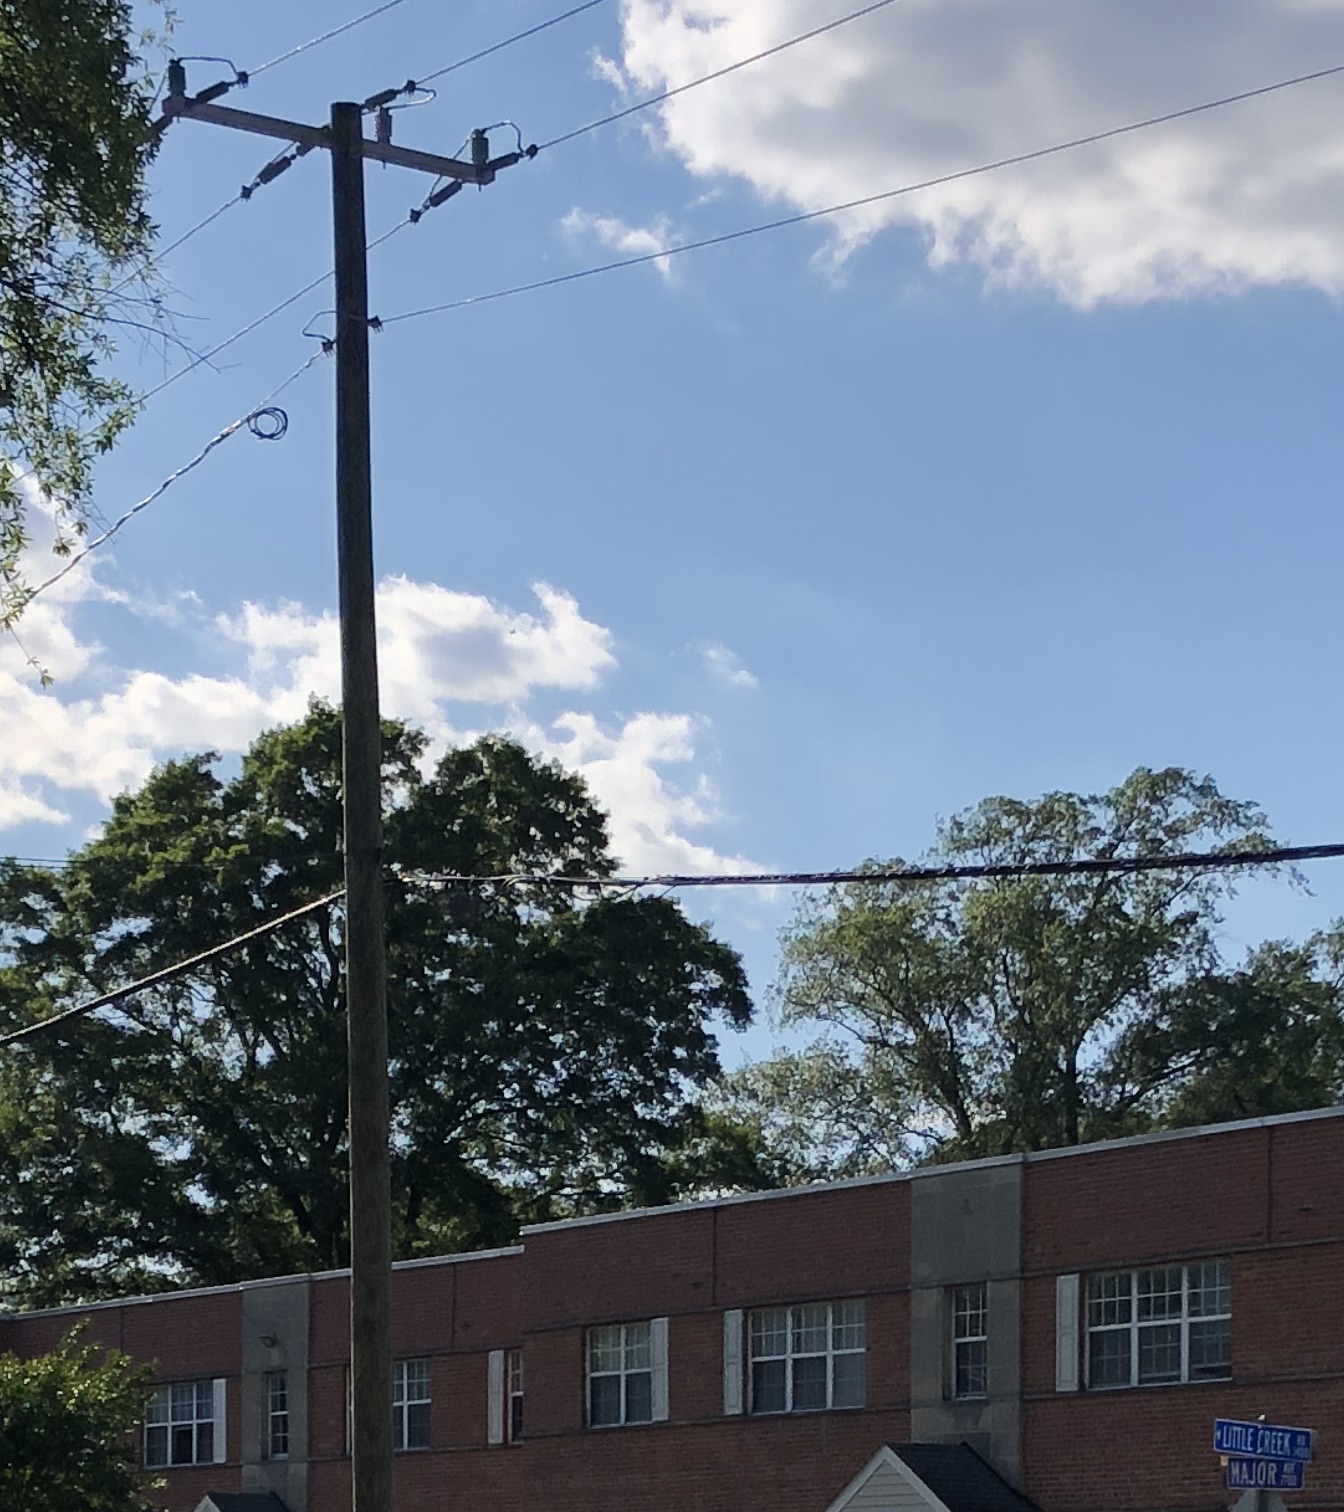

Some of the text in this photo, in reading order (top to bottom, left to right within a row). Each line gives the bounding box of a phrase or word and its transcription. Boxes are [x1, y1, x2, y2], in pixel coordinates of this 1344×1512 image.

[1223, 1425, 1254, 1451] LITTLE
[1257, 1430, 1291, 1456] CREEK
[1230, 1460, 1277, 1485] MAJOR
